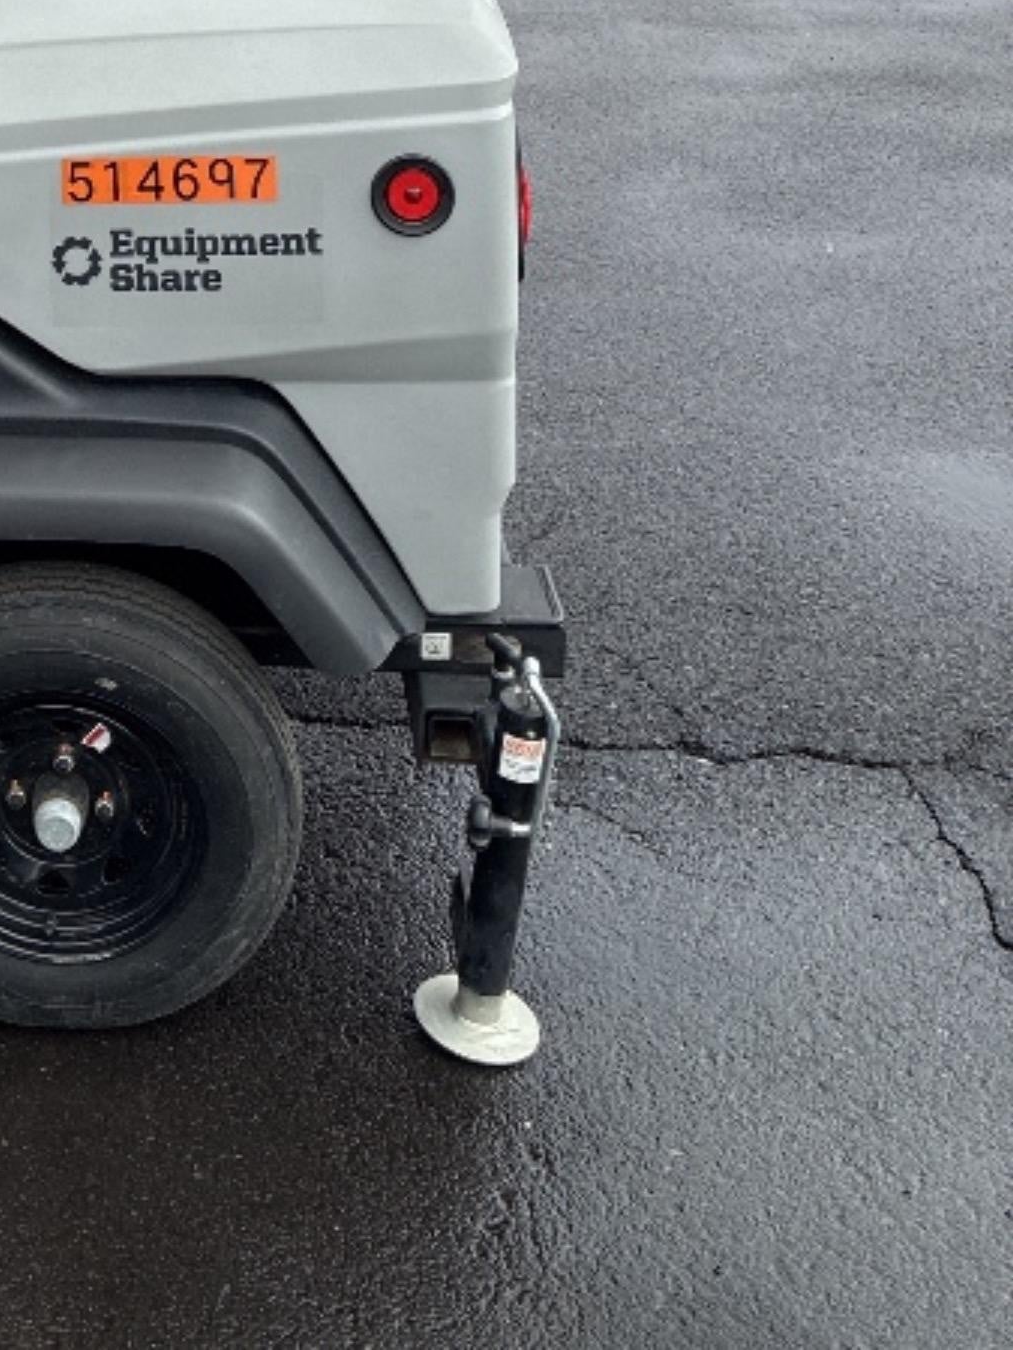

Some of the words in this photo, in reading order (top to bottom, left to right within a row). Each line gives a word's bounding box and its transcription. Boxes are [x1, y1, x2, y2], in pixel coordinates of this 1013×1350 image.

[67, 158, 270, 202] 514697
[109, 228, 323, 263] Equipment
[109, 264, 223, 292] Share
